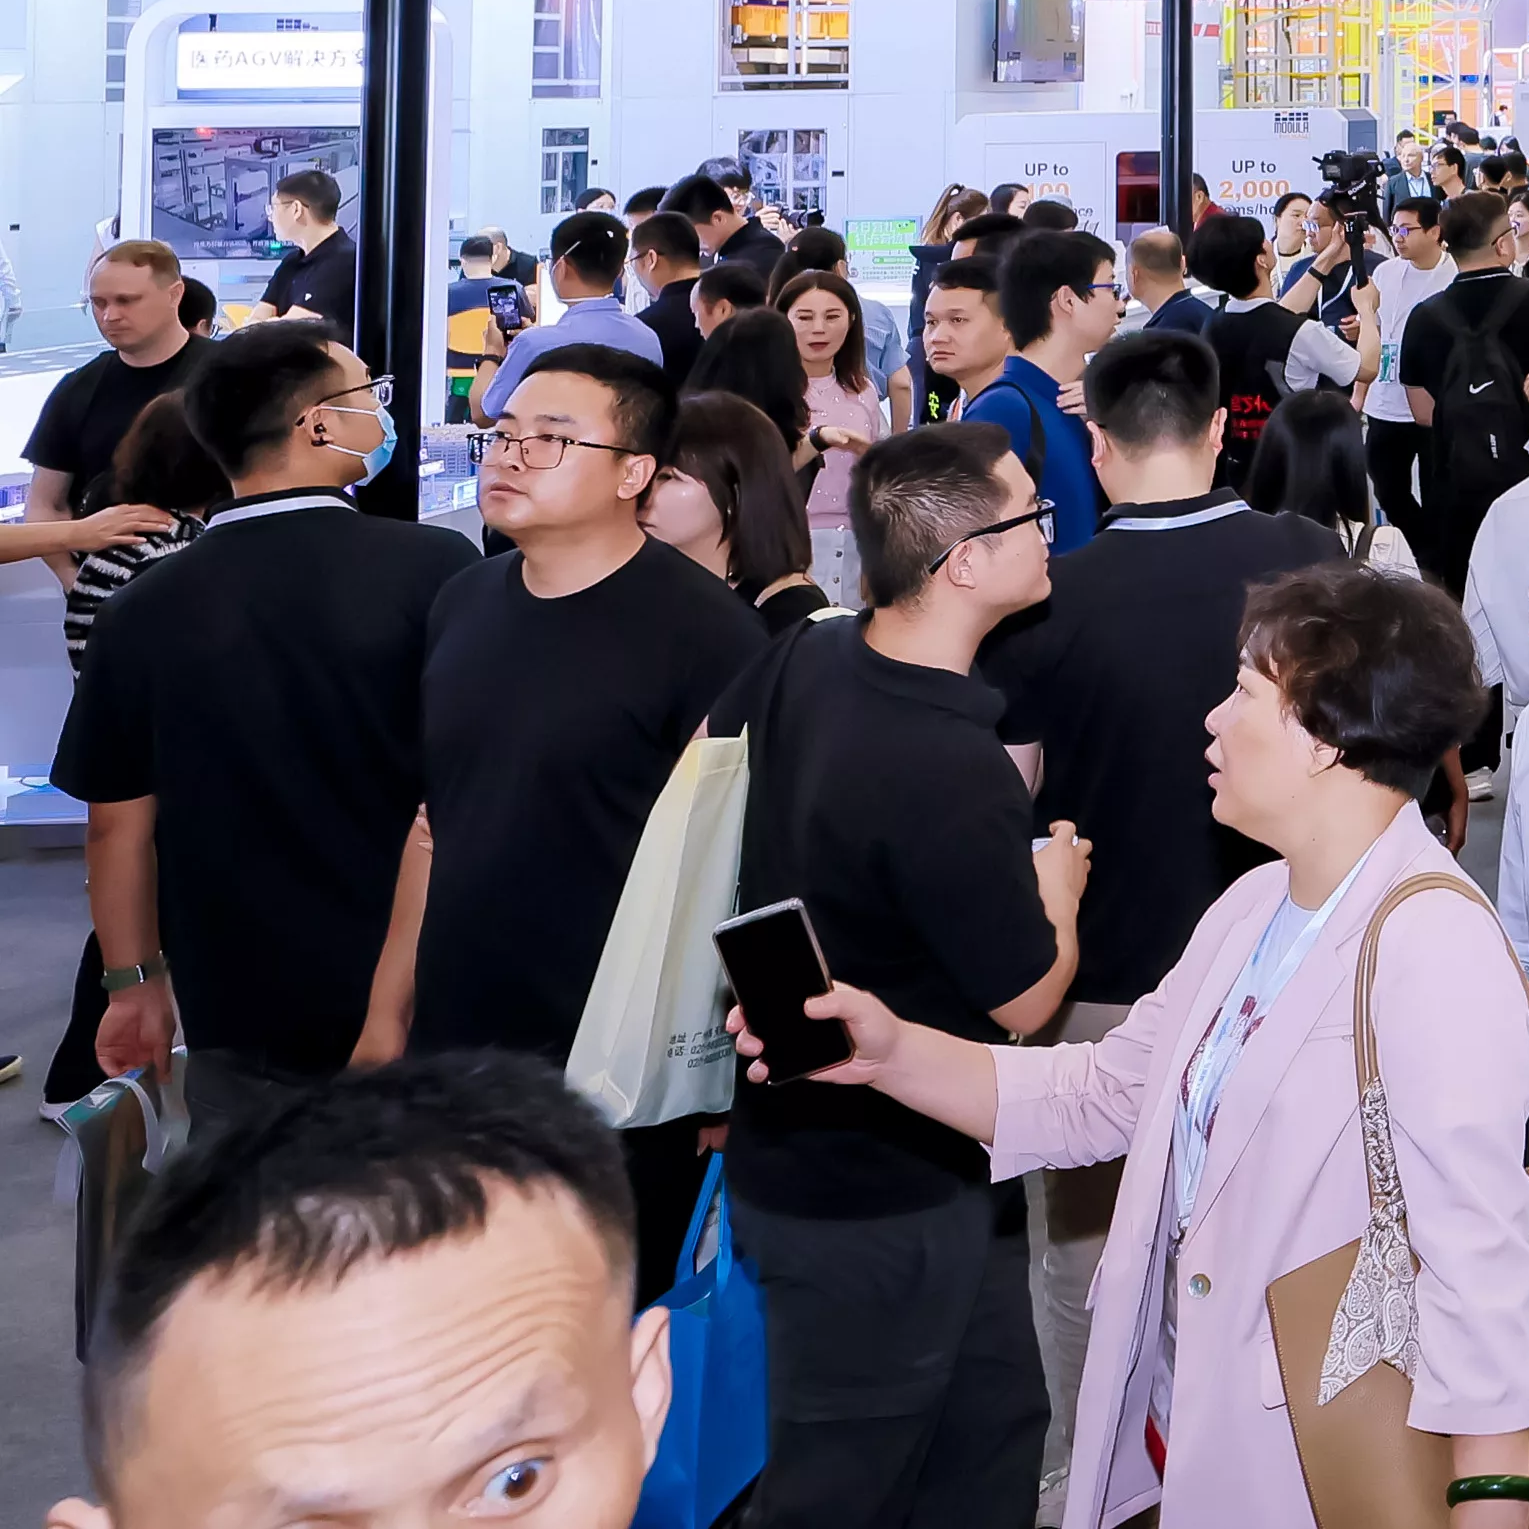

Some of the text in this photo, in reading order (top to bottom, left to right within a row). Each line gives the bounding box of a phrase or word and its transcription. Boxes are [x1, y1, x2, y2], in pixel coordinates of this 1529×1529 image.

[1274, 121, 1309, 134] MODULA
[1025, 163, 1069, 176] UP to
[1232, 160, 1277, 173] UP to
[1218, 179, 1290, 200] 2,000
